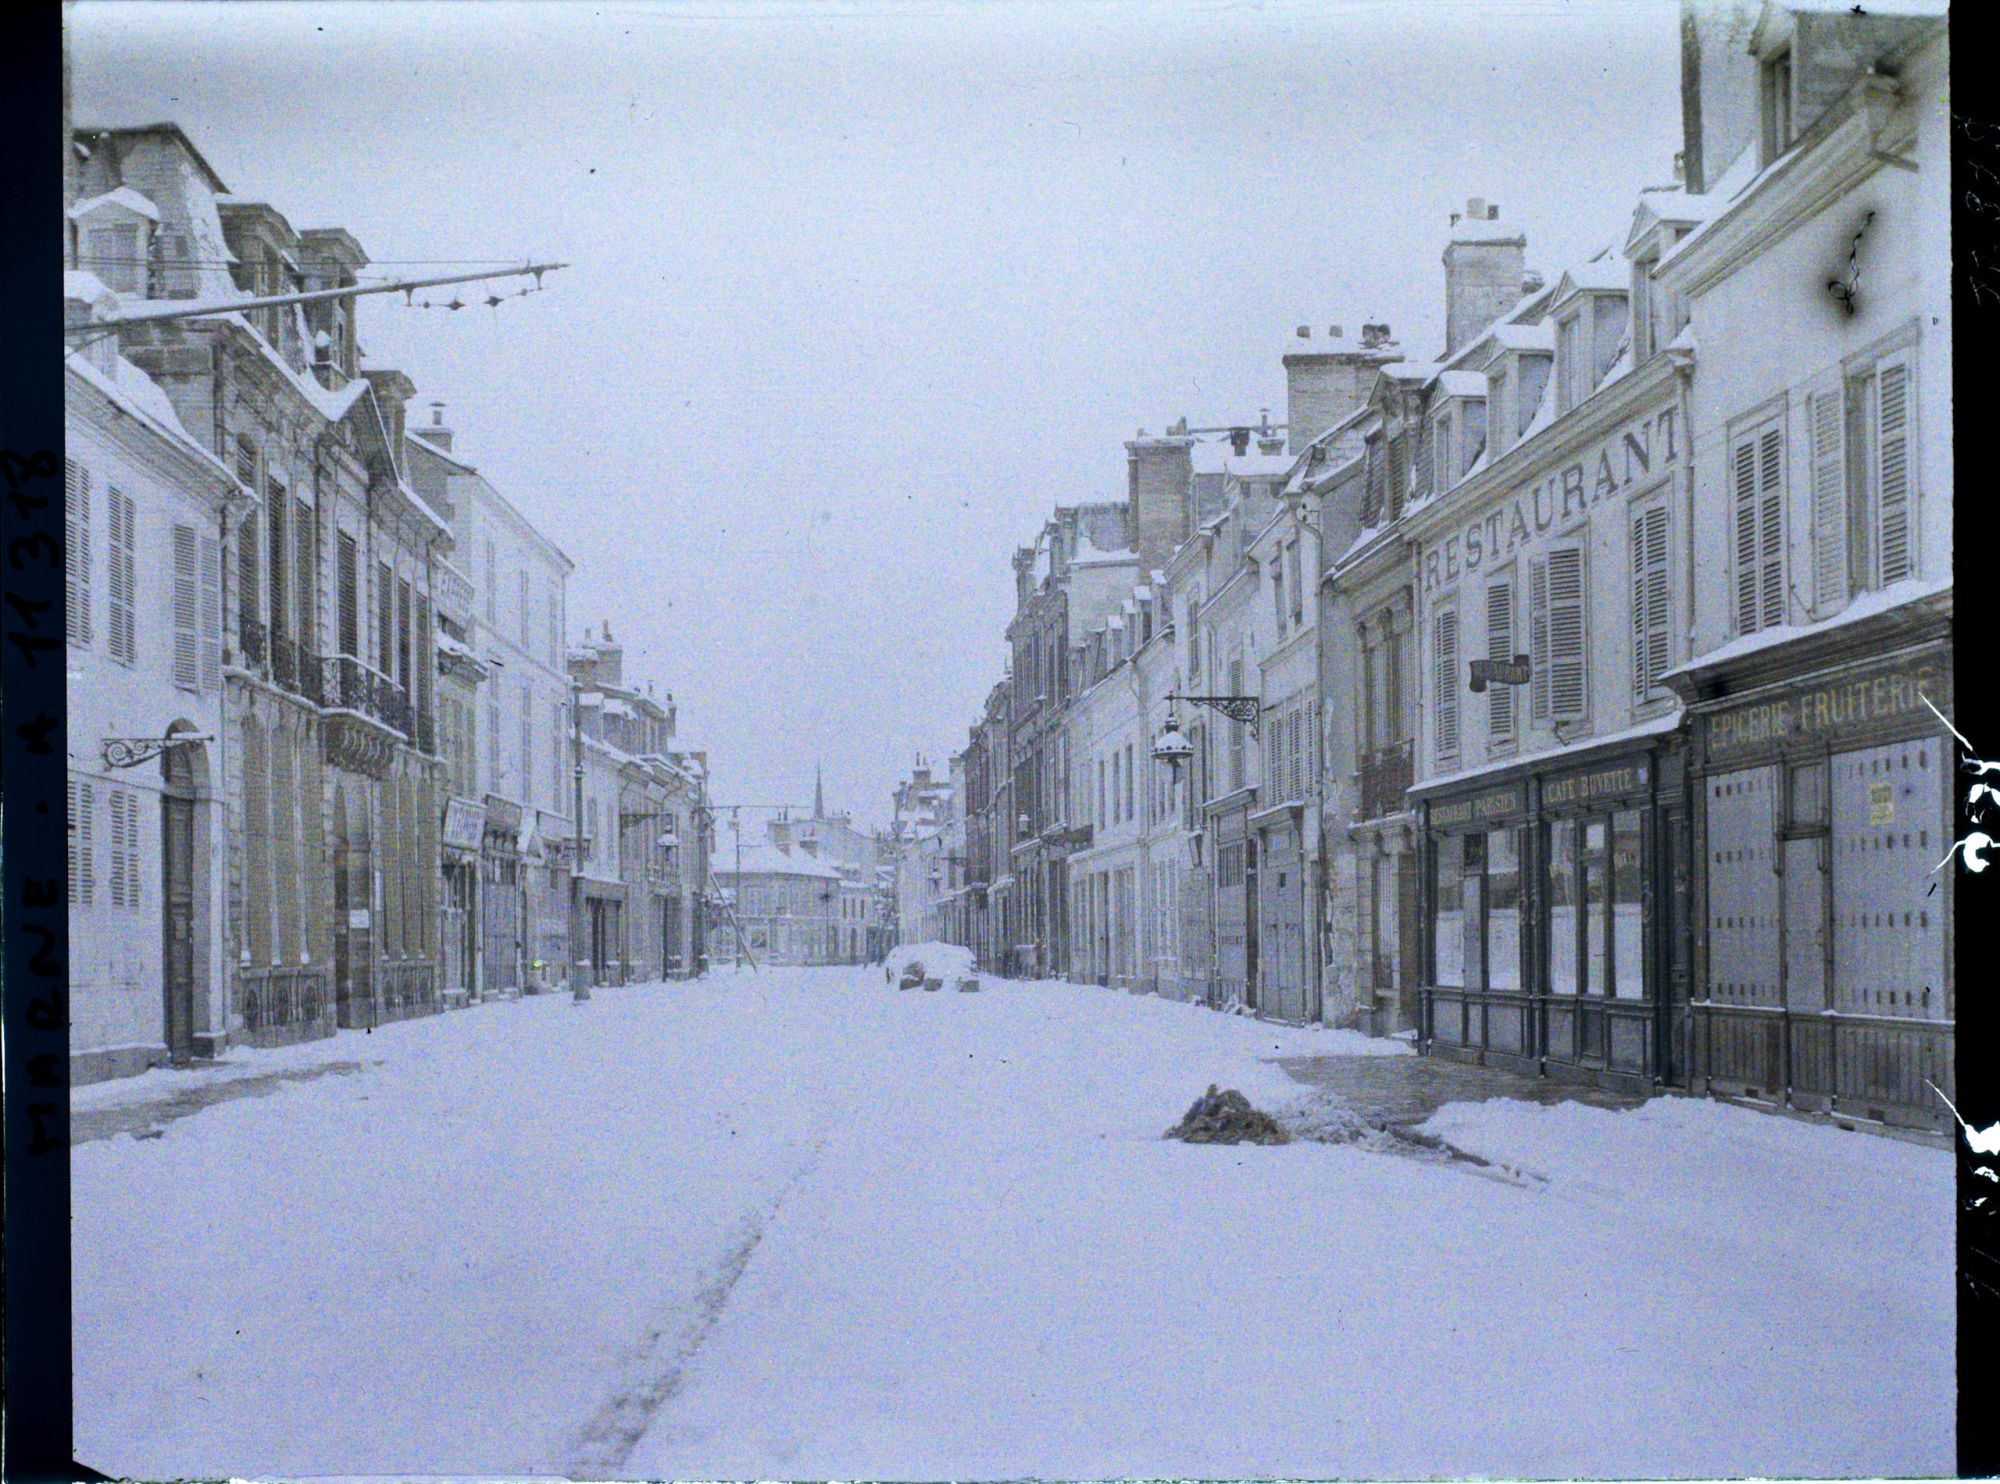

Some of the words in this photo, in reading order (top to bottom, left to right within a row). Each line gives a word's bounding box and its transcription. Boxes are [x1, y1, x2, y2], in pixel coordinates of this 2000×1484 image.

[1424, 403, 1680, 593] RESTAURANT
[1711, 701, 1789, 749] EPICERIE
[1800, 667, 1934, 730] FRUITERIE
[1580, 766, 1633, 797] BUVETTE
[20, 875, 65, 1157] MARNE
